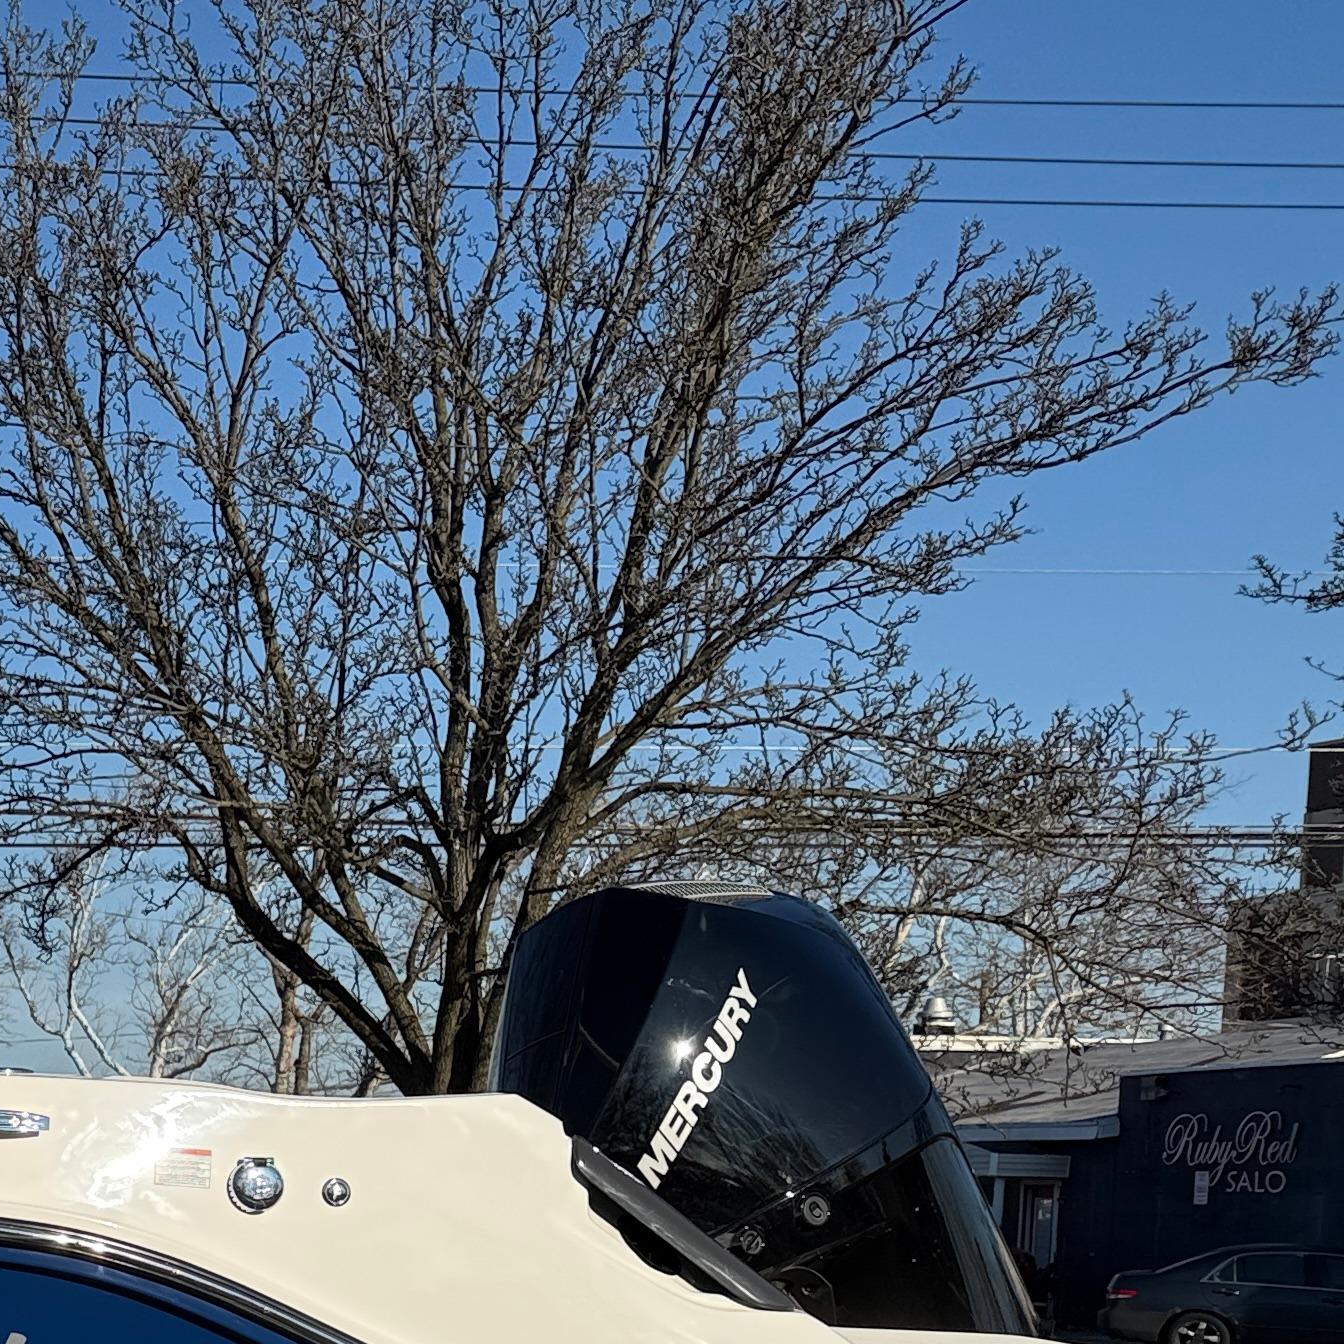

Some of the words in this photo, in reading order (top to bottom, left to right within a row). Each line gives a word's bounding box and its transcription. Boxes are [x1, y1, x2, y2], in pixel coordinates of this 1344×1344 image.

[636, 967, 759, 1190] MERCURY
[1162, 1113, 1233, 1187] Ruby
[1232, 1110, 1299, 1166] Red
[1225, 1170, 1287, 1193] SALO
